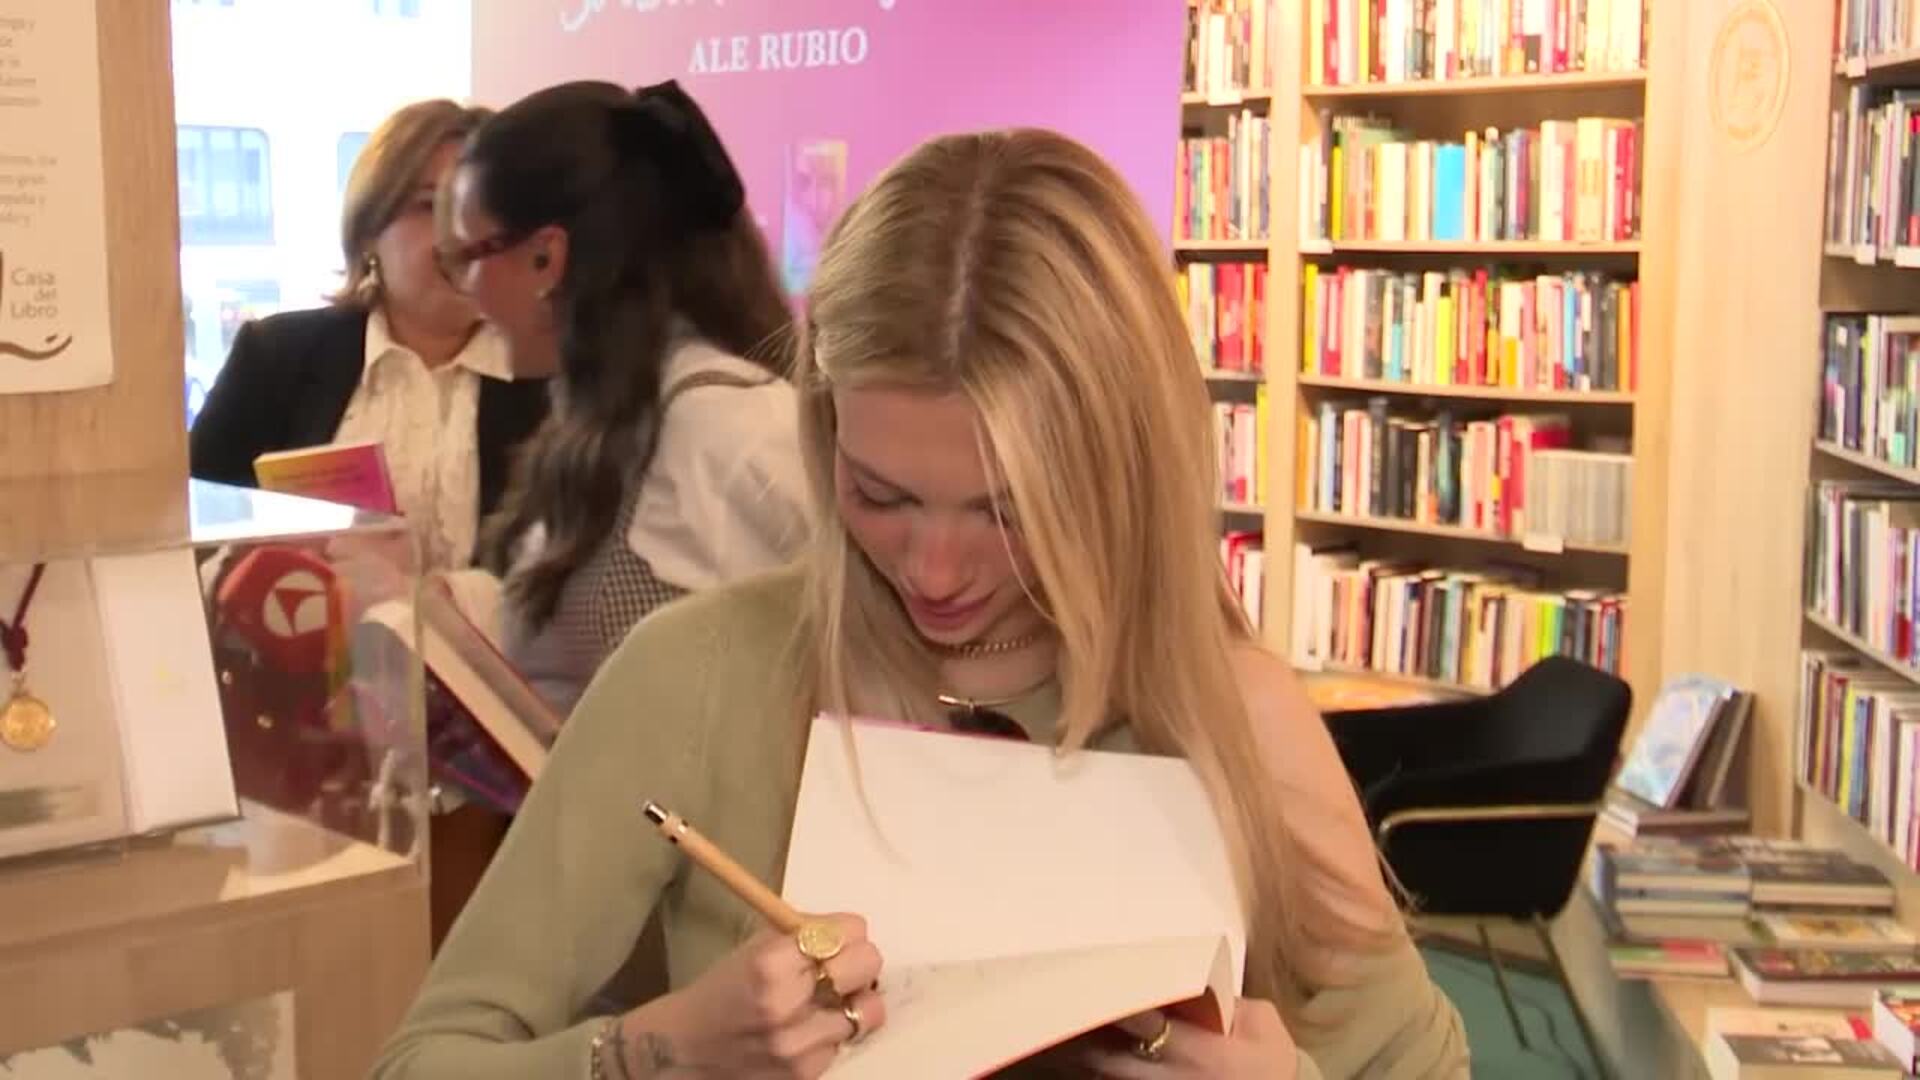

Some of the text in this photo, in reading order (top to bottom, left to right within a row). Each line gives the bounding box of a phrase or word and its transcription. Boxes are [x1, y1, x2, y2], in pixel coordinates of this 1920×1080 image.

[688, 27, 868, 73] ALE RUBIO
[11, 267, 55, 287] Casa
[34, 287, 57, 301] del
[11, 301, 58, 319] Libro
